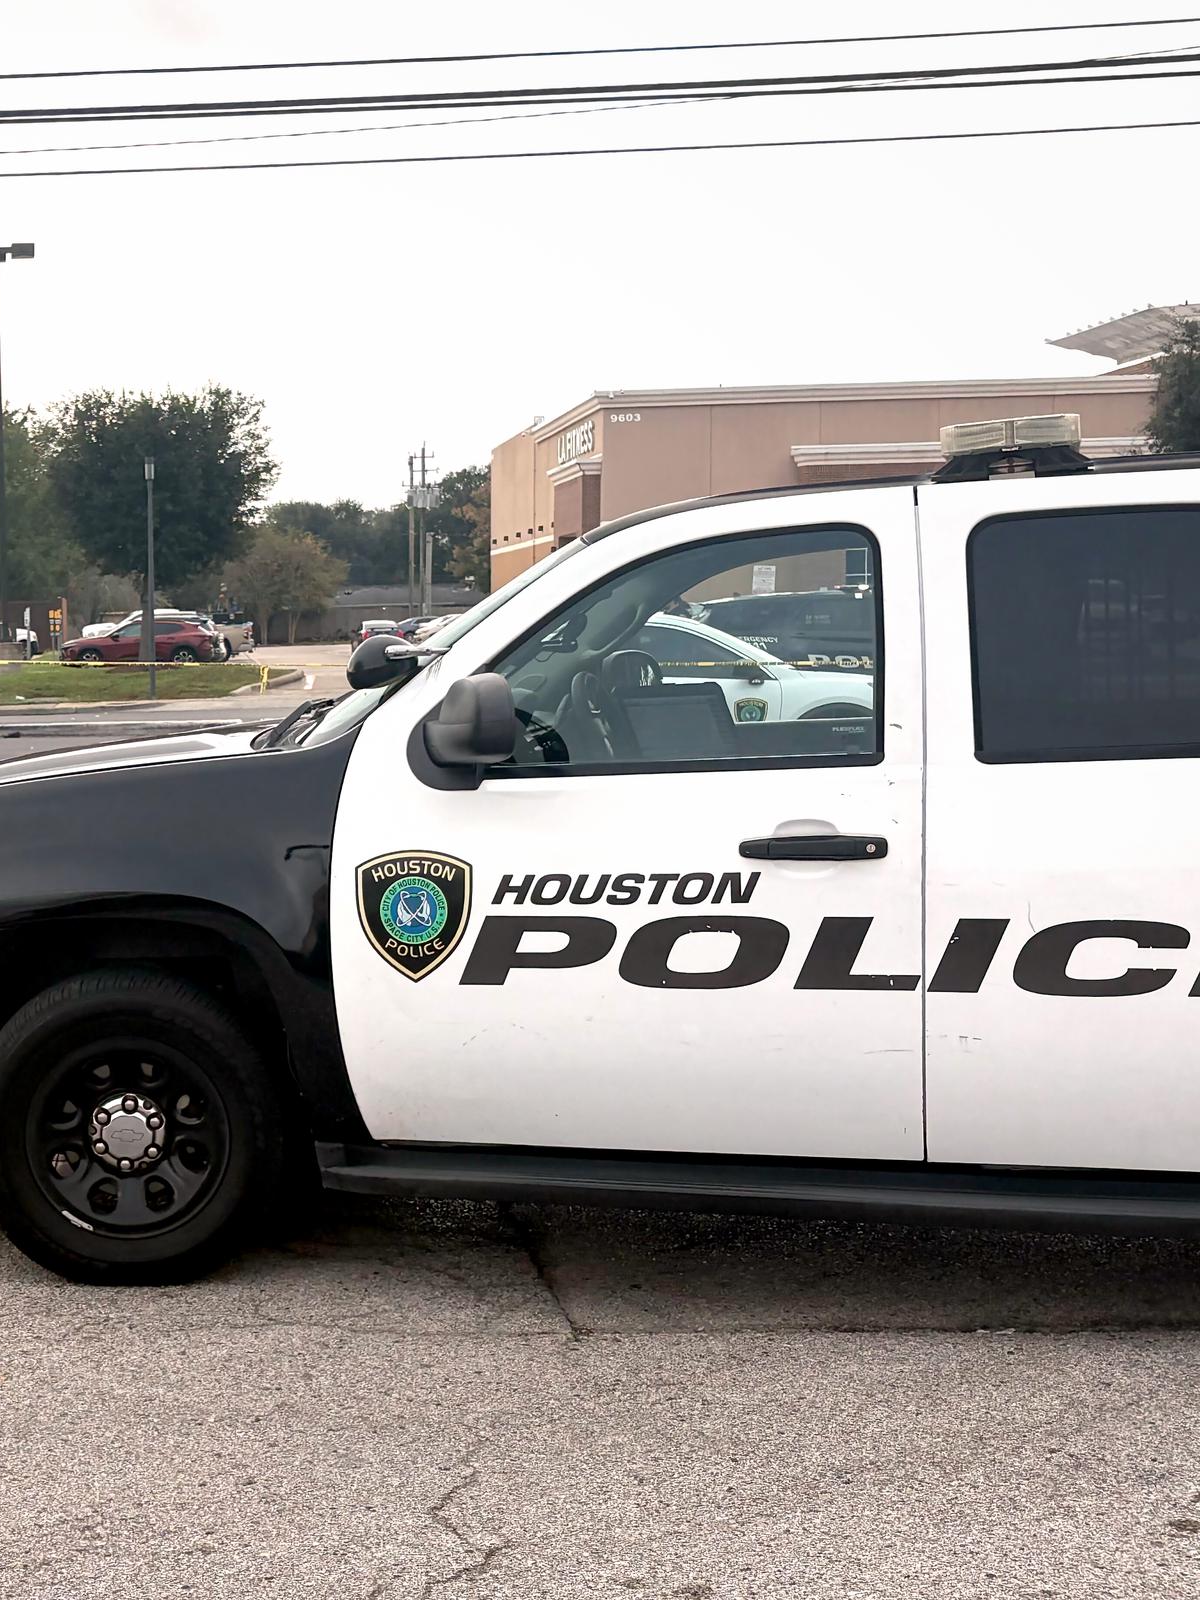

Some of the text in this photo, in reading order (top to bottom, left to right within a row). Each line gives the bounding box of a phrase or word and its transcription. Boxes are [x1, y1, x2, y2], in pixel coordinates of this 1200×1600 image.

[610, 413, 641, 423] 9603
[566, 420, 593, 460] FITNESS
[807, 654, 873, 668] POL
[371, 860, 457, 882] HOUSTON
[382, 895, 392, 911] CITY
[398, 878, 430, 890] HOUSTON
[430, 886, 446, 911] POLICE
[491, 871, 762, 906] HOUSTON
[384, 918, 406, 940] SPACE
[406, 935, 424, 943] CITY
[384, 938, 445, 958] POLICE
[458, 915, 1200, 998] POLIC
